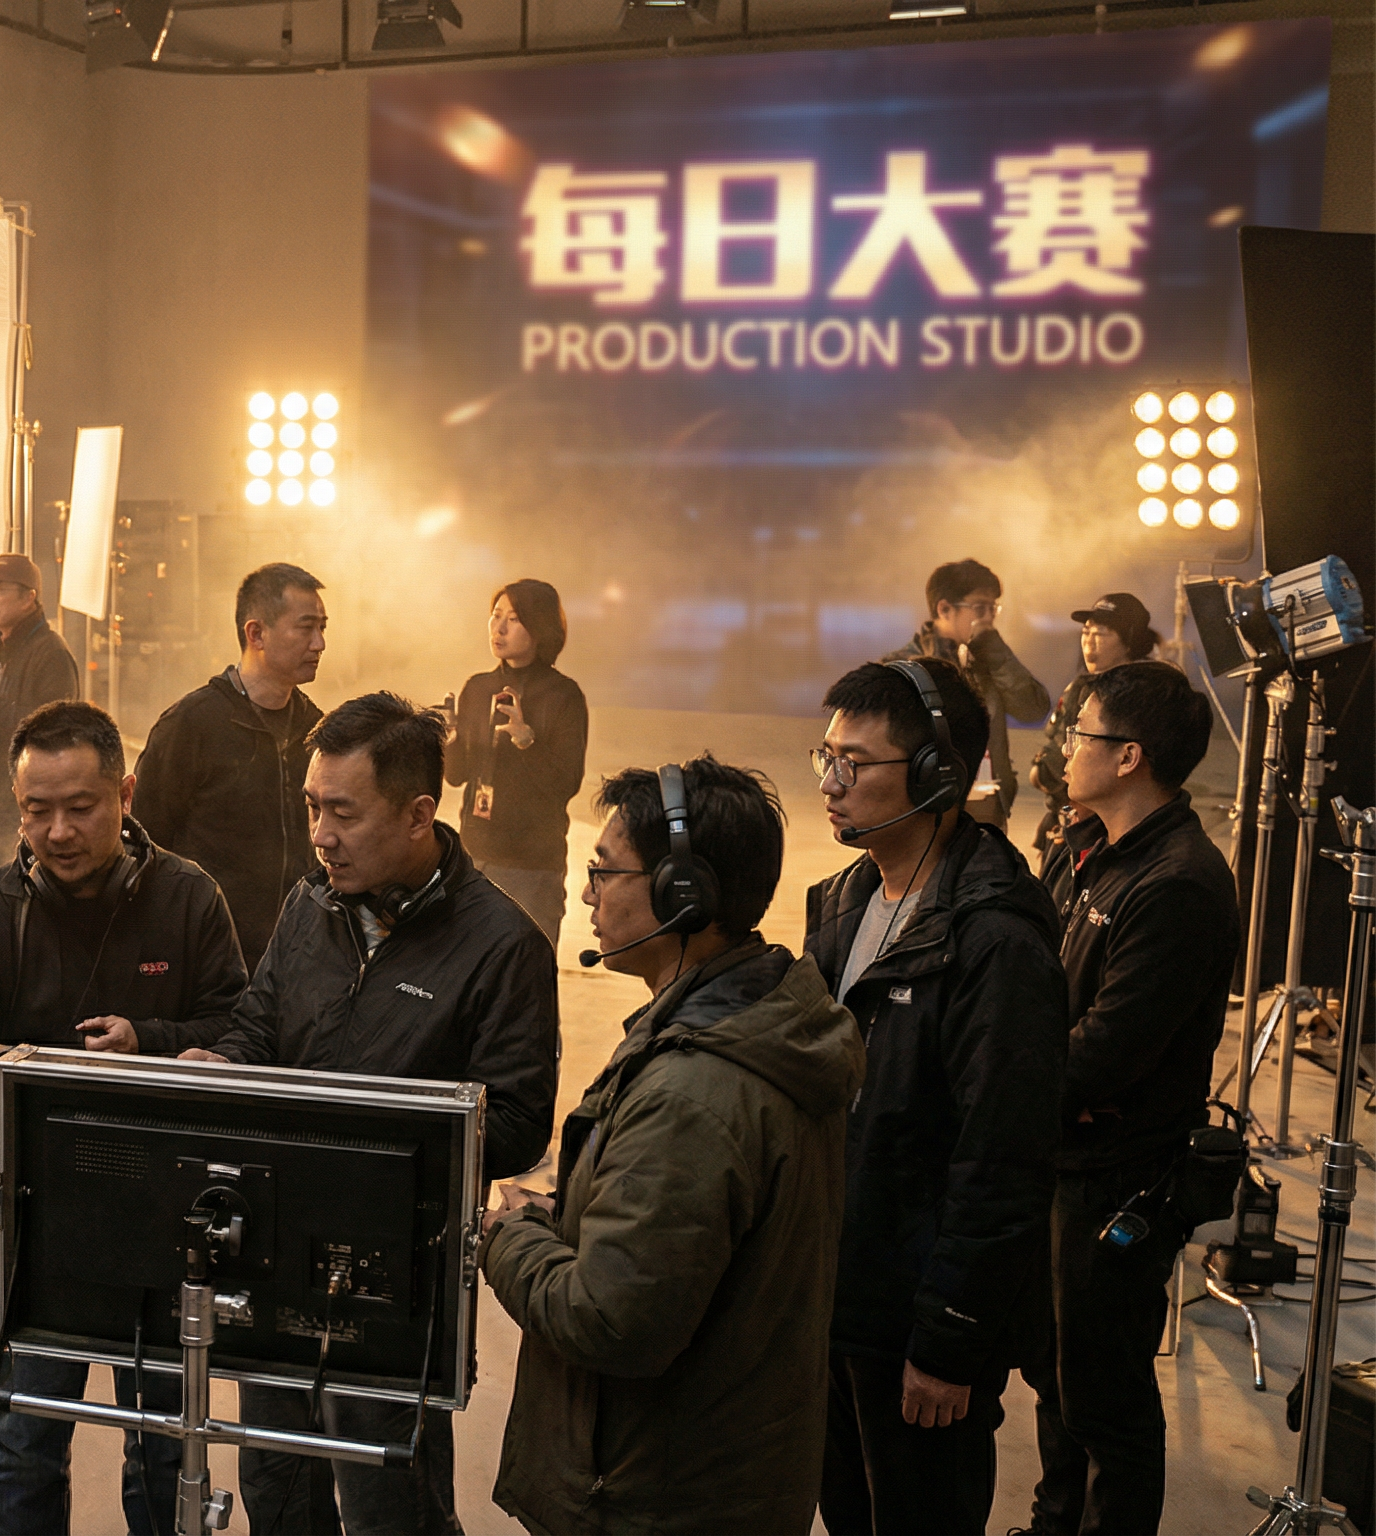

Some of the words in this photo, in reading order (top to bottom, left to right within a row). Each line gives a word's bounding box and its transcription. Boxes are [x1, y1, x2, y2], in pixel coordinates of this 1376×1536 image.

[520, 144, 1150, 306] 每日大赛
[523, 320, 900, 371] PRODUCTION
[921, 313, 1144, 367] STUDIO
